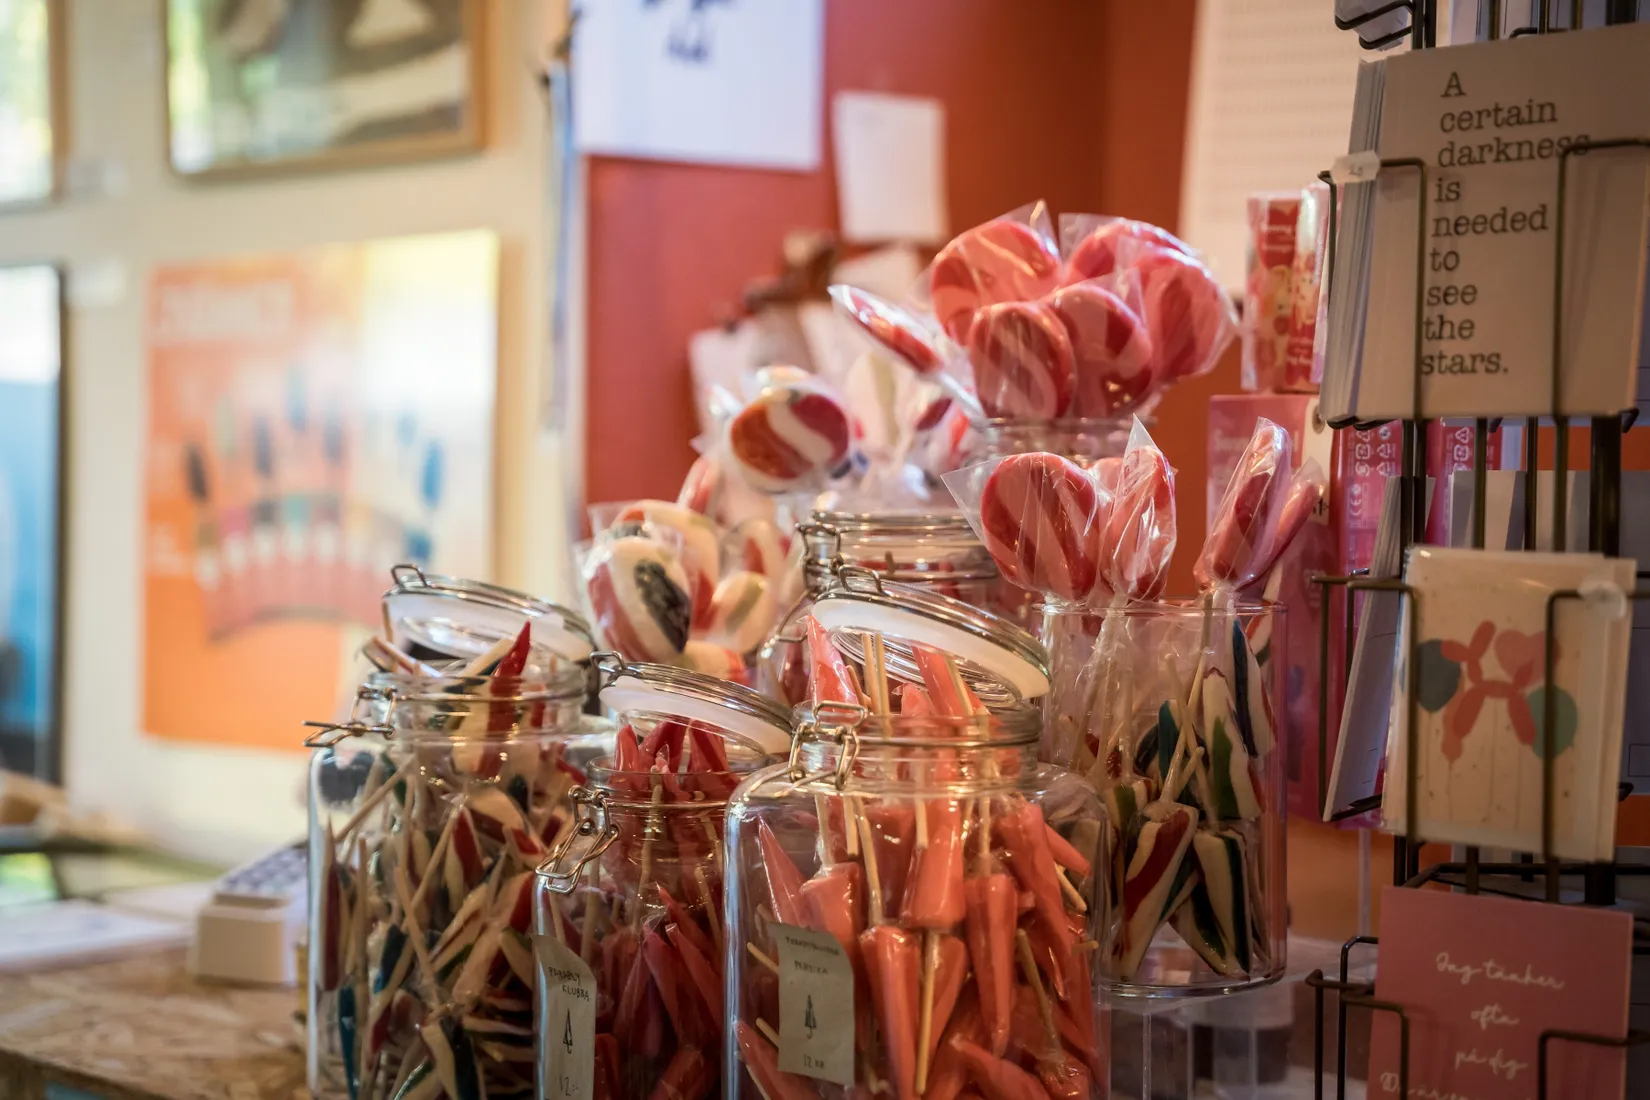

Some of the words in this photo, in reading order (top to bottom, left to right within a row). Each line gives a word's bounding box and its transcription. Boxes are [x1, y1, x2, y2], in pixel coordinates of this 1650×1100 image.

[1440, 72, 1466, 98] A
[1440, 99, 1558, 133] certain
[1438, 134, 1591, 167] darkness
[1433, 177, 1462, 202] is
[1431, 204, 1549, 237] needed
[1430, 248, 1461, 272] to
[1426, 283, 1478, 307] see
[1422, 315, 1475, 340] the
[1420, 351, 1509, 376] stars.
[562, 984, 590, 1002] KLUBBA
